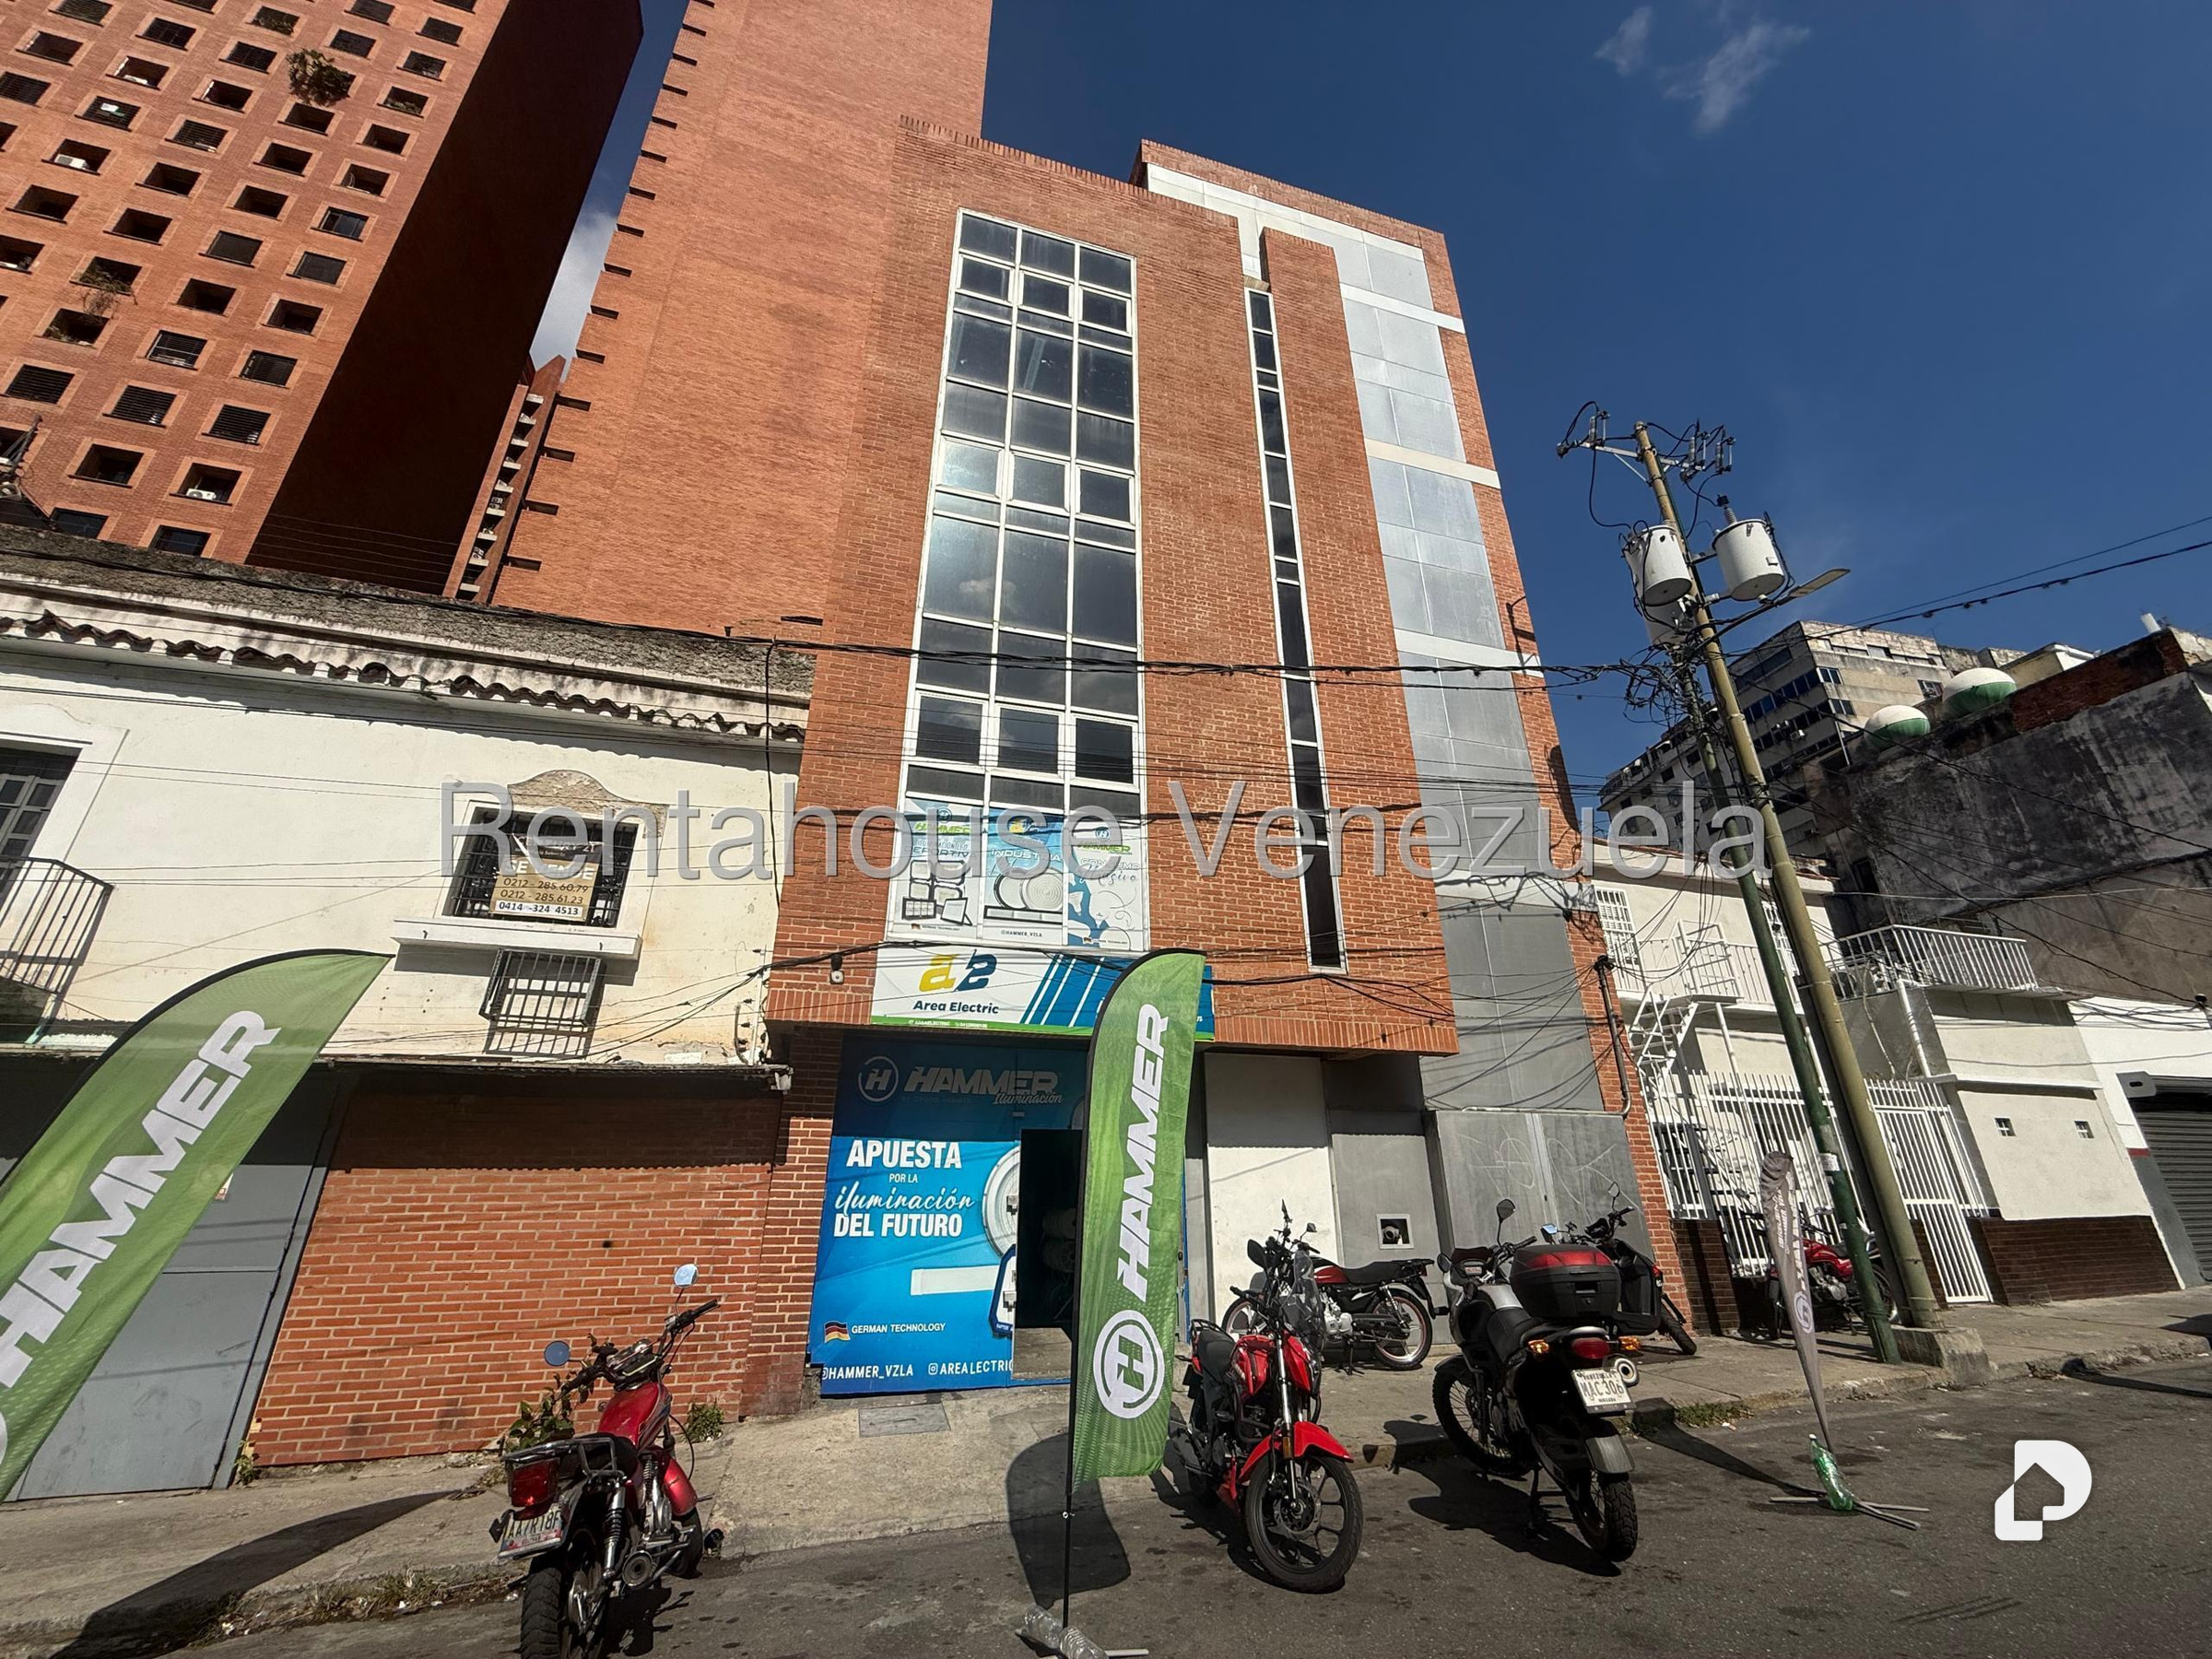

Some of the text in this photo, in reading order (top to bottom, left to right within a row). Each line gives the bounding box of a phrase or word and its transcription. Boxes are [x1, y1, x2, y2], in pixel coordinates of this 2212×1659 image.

[1081, 858, 1141, 870] CONUMO
[503, 877, 529, 888] 0212
[538, 880, 589, 893] 285.60.79
[500, 889, 525, 900] 0212
[535, 892, 583, 905] 285.61.23
[499, 901, 524, 912] 0414
[555, 906, 579, 915] 4513
[912, 1000, 999, 1014] Area Electric
[904, 1065, 1059, 1096] HAMMER
[993, 1090, 1063, 1105] Iluminación
[845, 1139, 962, 1170] APUESTA
[1116, 1003, 1169, 1303] HAMMER
[888, 1173, 918, 1183] POR LA
[834, 1181, 975, 1217] iluminación
[833, 1213, 963, 1238] DEL FUTURO
[851, 1322, 947, 1335] GERMAN TECHNOLOGY
[1579, 1380, 1625, 1397] MAC306
